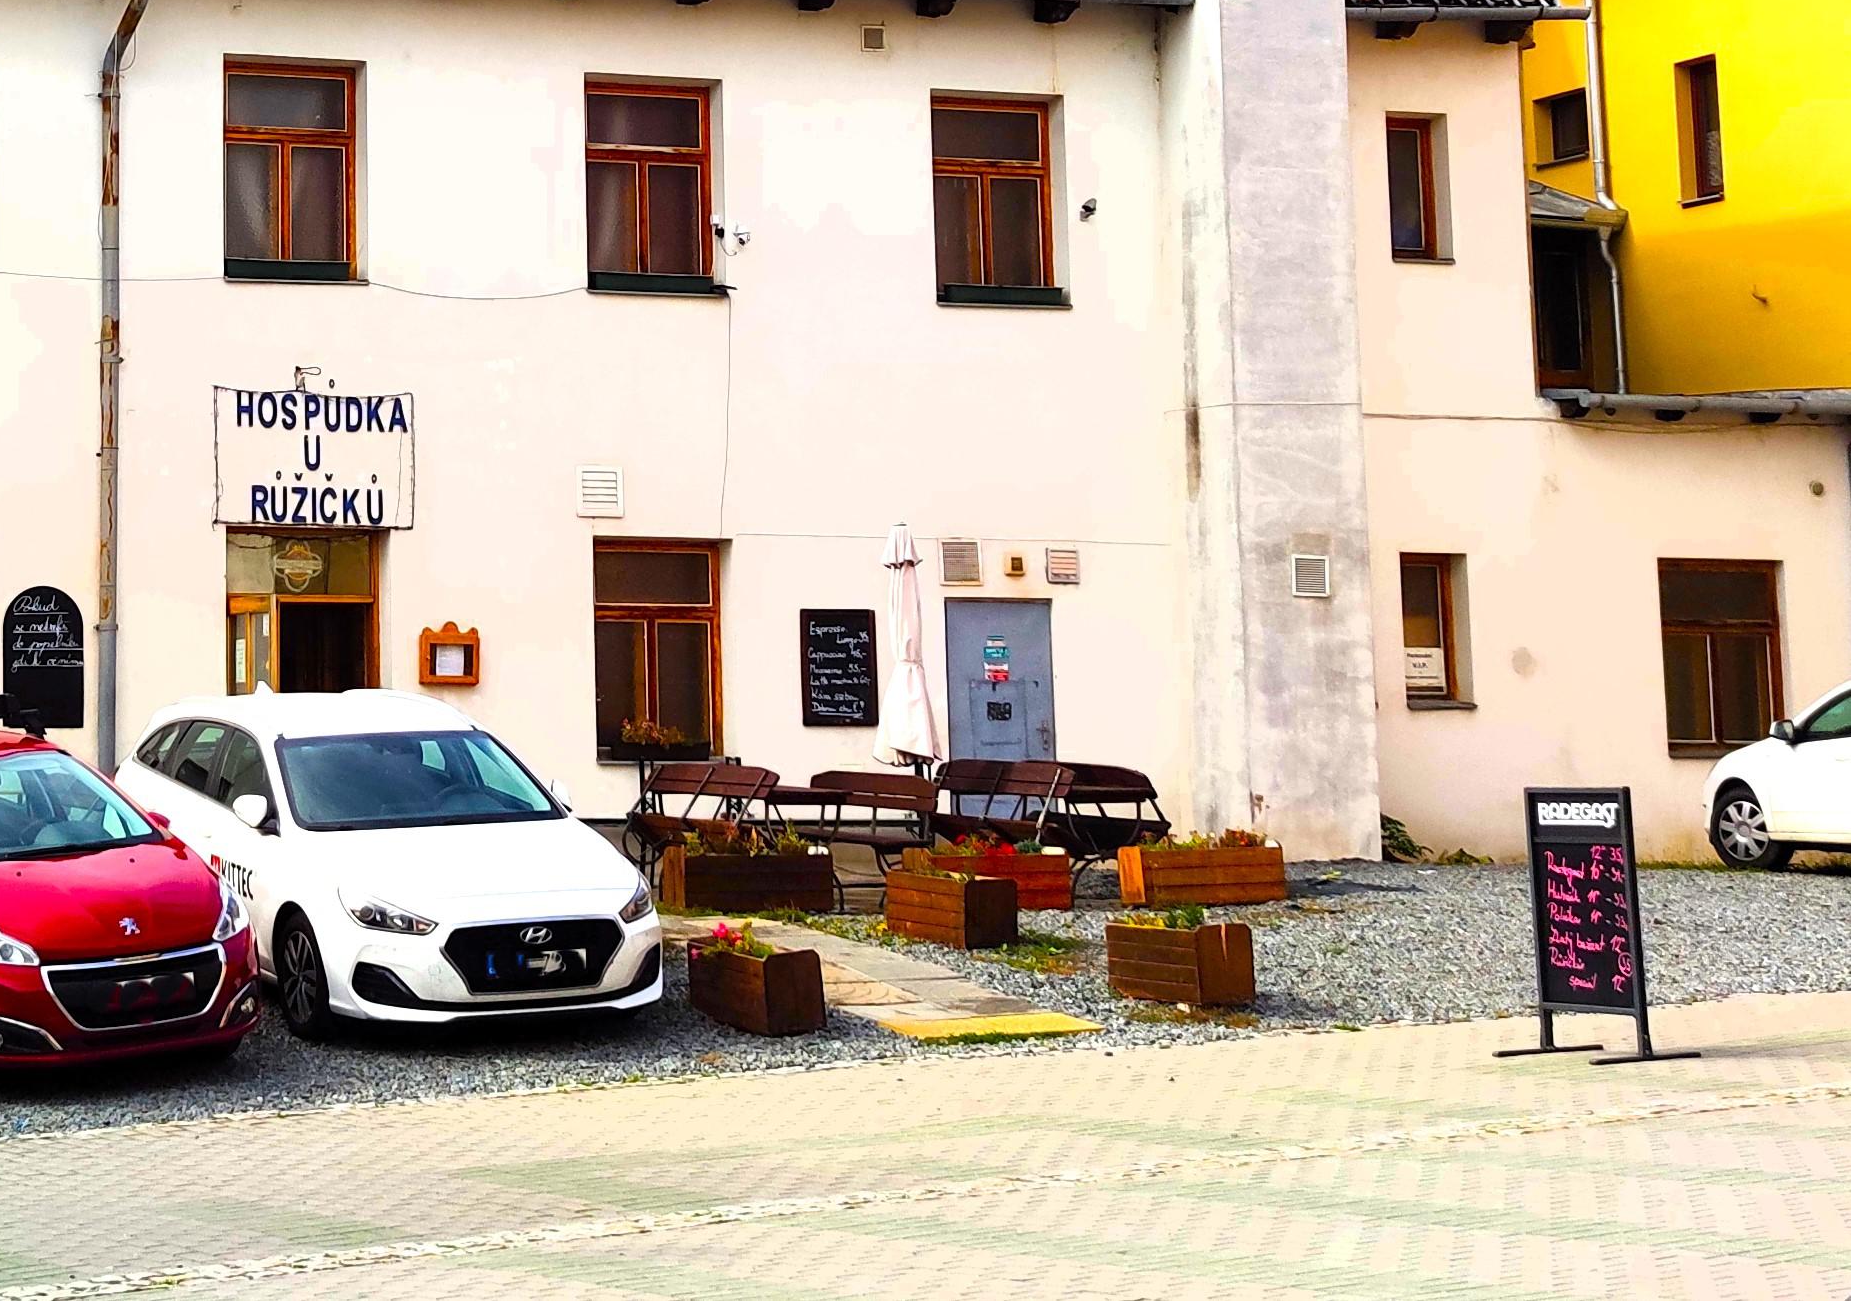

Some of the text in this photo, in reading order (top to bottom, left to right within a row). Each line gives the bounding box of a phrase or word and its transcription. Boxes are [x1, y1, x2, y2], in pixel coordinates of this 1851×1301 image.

[236, 379, 408, 433] HOSPŮDKA
[303, 435, 321, 471] U
[251, 470, 384, 525] RŮŽIČKŮ
[1537, 802, 1619, 827] RADEGAST
[221, 858, 254, 901] KITTEC
